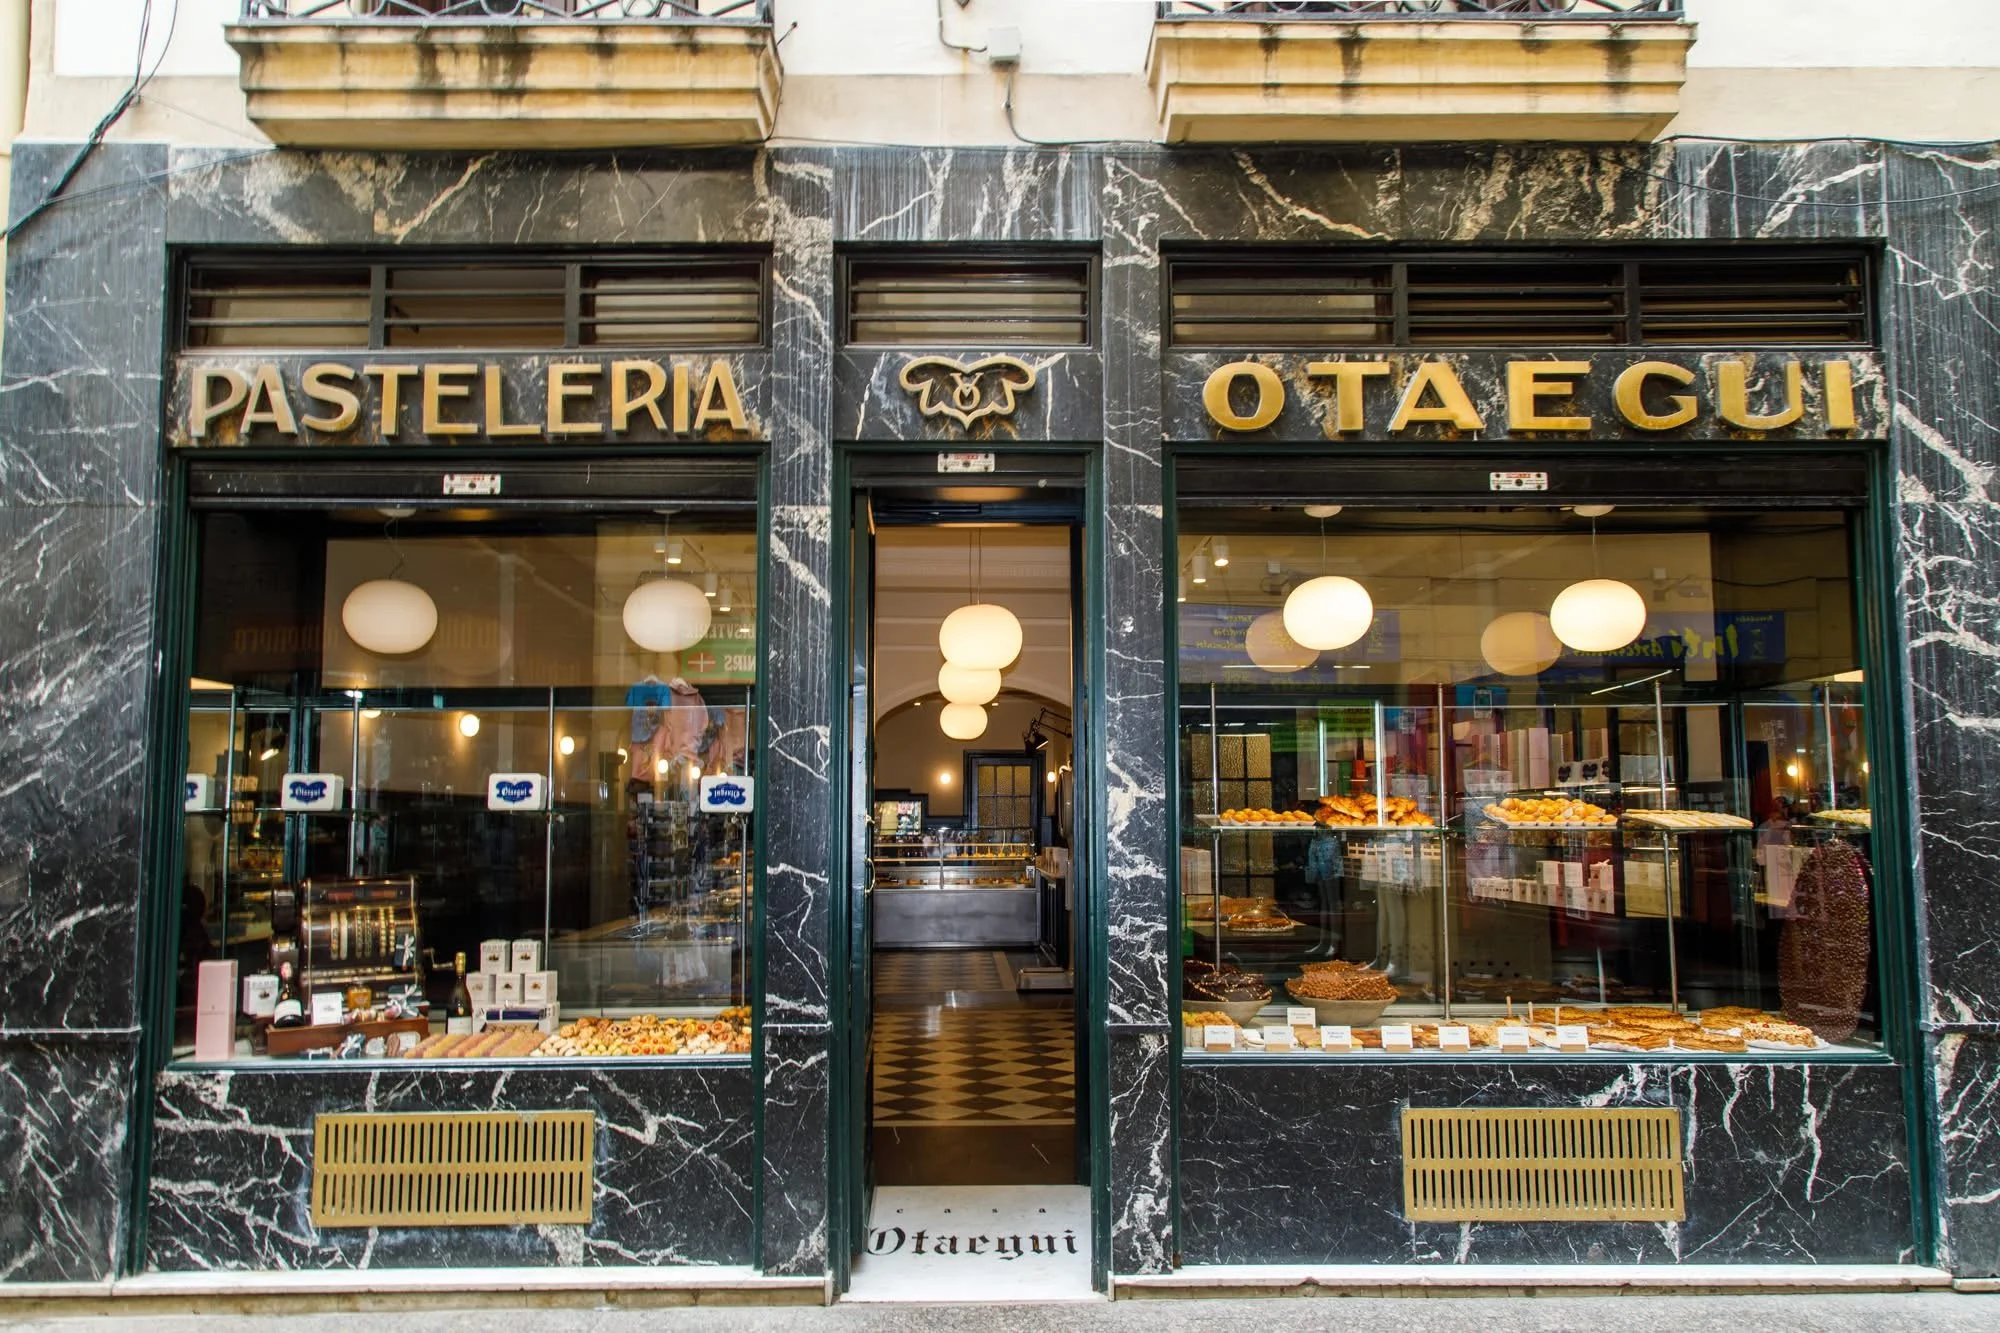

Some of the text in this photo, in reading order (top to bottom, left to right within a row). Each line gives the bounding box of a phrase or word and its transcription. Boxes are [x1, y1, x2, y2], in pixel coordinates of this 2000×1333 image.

[190, 360, 749, 437] PASTELERIA
[1201, 361, 1855, 432] OTAEGUI
[867, 1226, 1079, 1261] Otaegui
